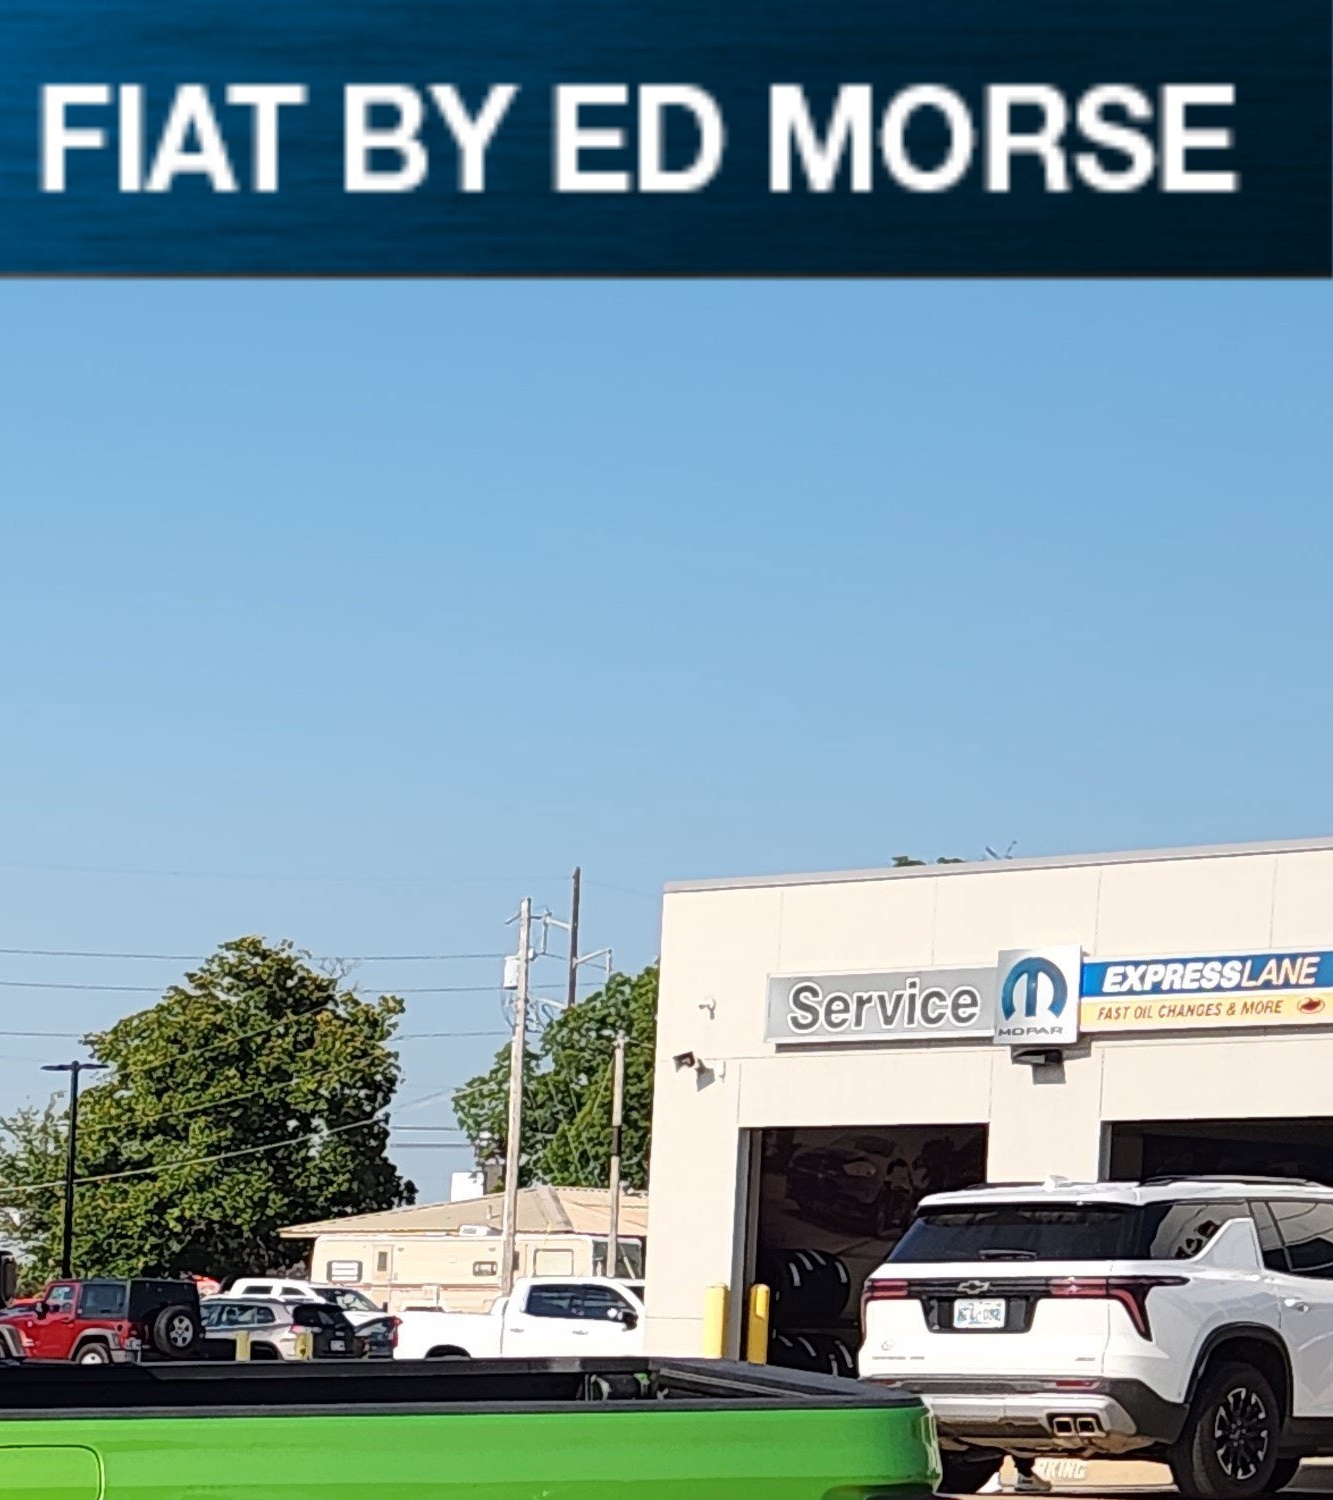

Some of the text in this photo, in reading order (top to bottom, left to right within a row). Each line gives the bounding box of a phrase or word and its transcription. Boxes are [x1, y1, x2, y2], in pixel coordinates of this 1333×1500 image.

[787, 978, 981, 1033] Service
[1097, 999, 1284, 1021] FAST OIL CHANGES & MORE
[997, 1025, 1064, 1037] MOPAR
